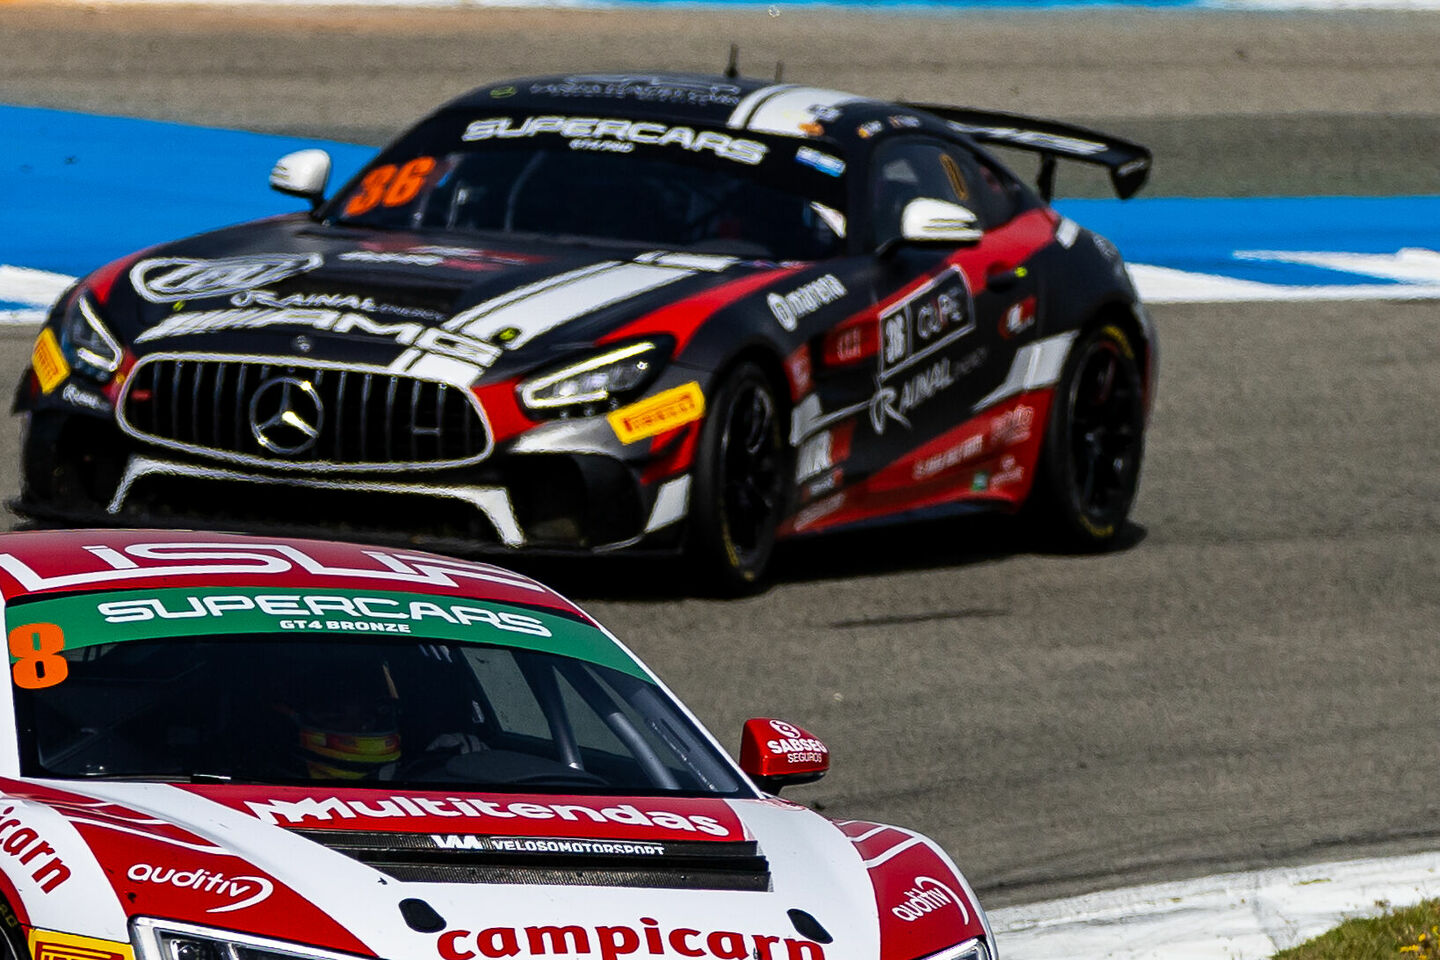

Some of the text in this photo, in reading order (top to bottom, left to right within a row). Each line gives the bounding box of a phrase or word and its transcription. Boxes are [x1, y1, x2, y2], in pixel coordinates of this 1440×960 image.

[462, 115, 769, 165] SUPERCARS
[98, 596, 552, 637] SUPERCARS
[280, 619, 411, 633] GT4 BRONZE
[8, 623, 68, 689] 8
[767, 738, 828, 754] SABSEG
[787, 752, 822, 764] SEGUROS
[127, 863, 252, 898] auditiv
[891, 881, 953, 922] auditiv
